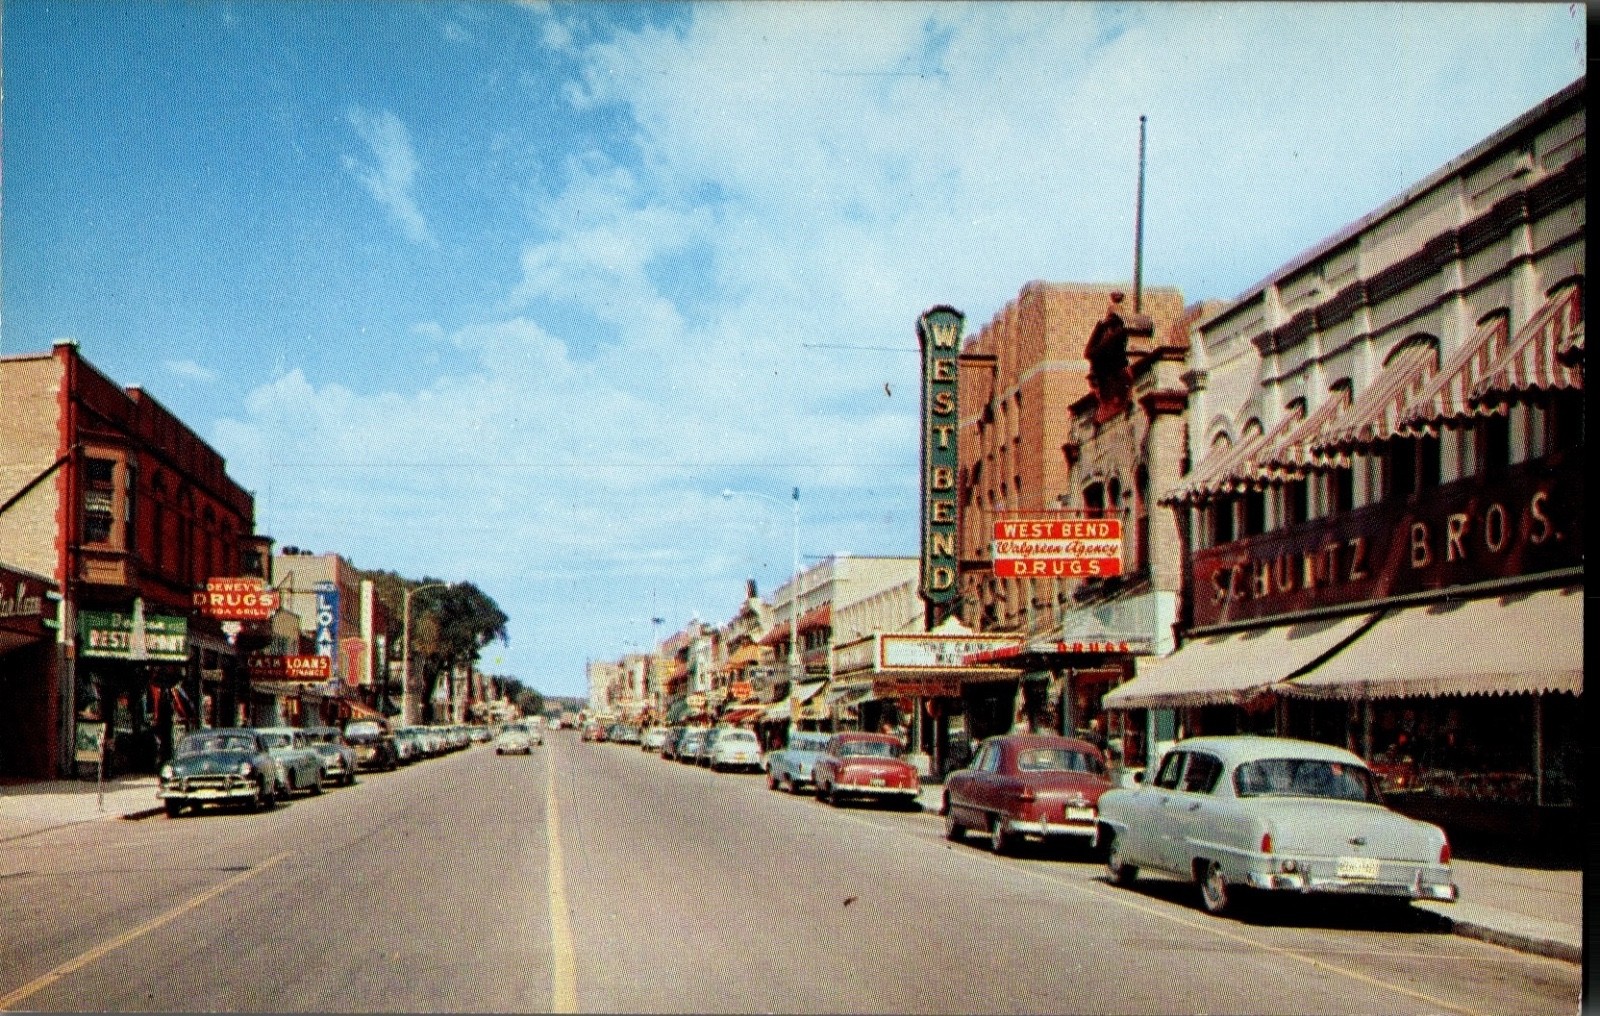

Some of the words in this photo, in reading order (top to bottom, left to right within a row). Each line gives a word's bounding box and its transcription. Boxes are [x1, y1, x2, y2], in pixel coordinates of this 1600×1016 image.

[931, 322, 957, 448] WEST
[931, 466, 956, 591] BEND
[1003, 523, 1054, 538] WEST
[1062, 523, 1109, 538] BEND
[996, 541, 1061, 558] Walgreen
[1065, 541, 1118, 558] Agency
[1014, 560, 1101, 574] DRUGS
[1210, 537, 1369, 604] SCHULTZ
[192, 592, 274, 606] DRUGS
[1056, 640, 1129, 654] DRUGS
[286, 656, 328, 669] LOANS
